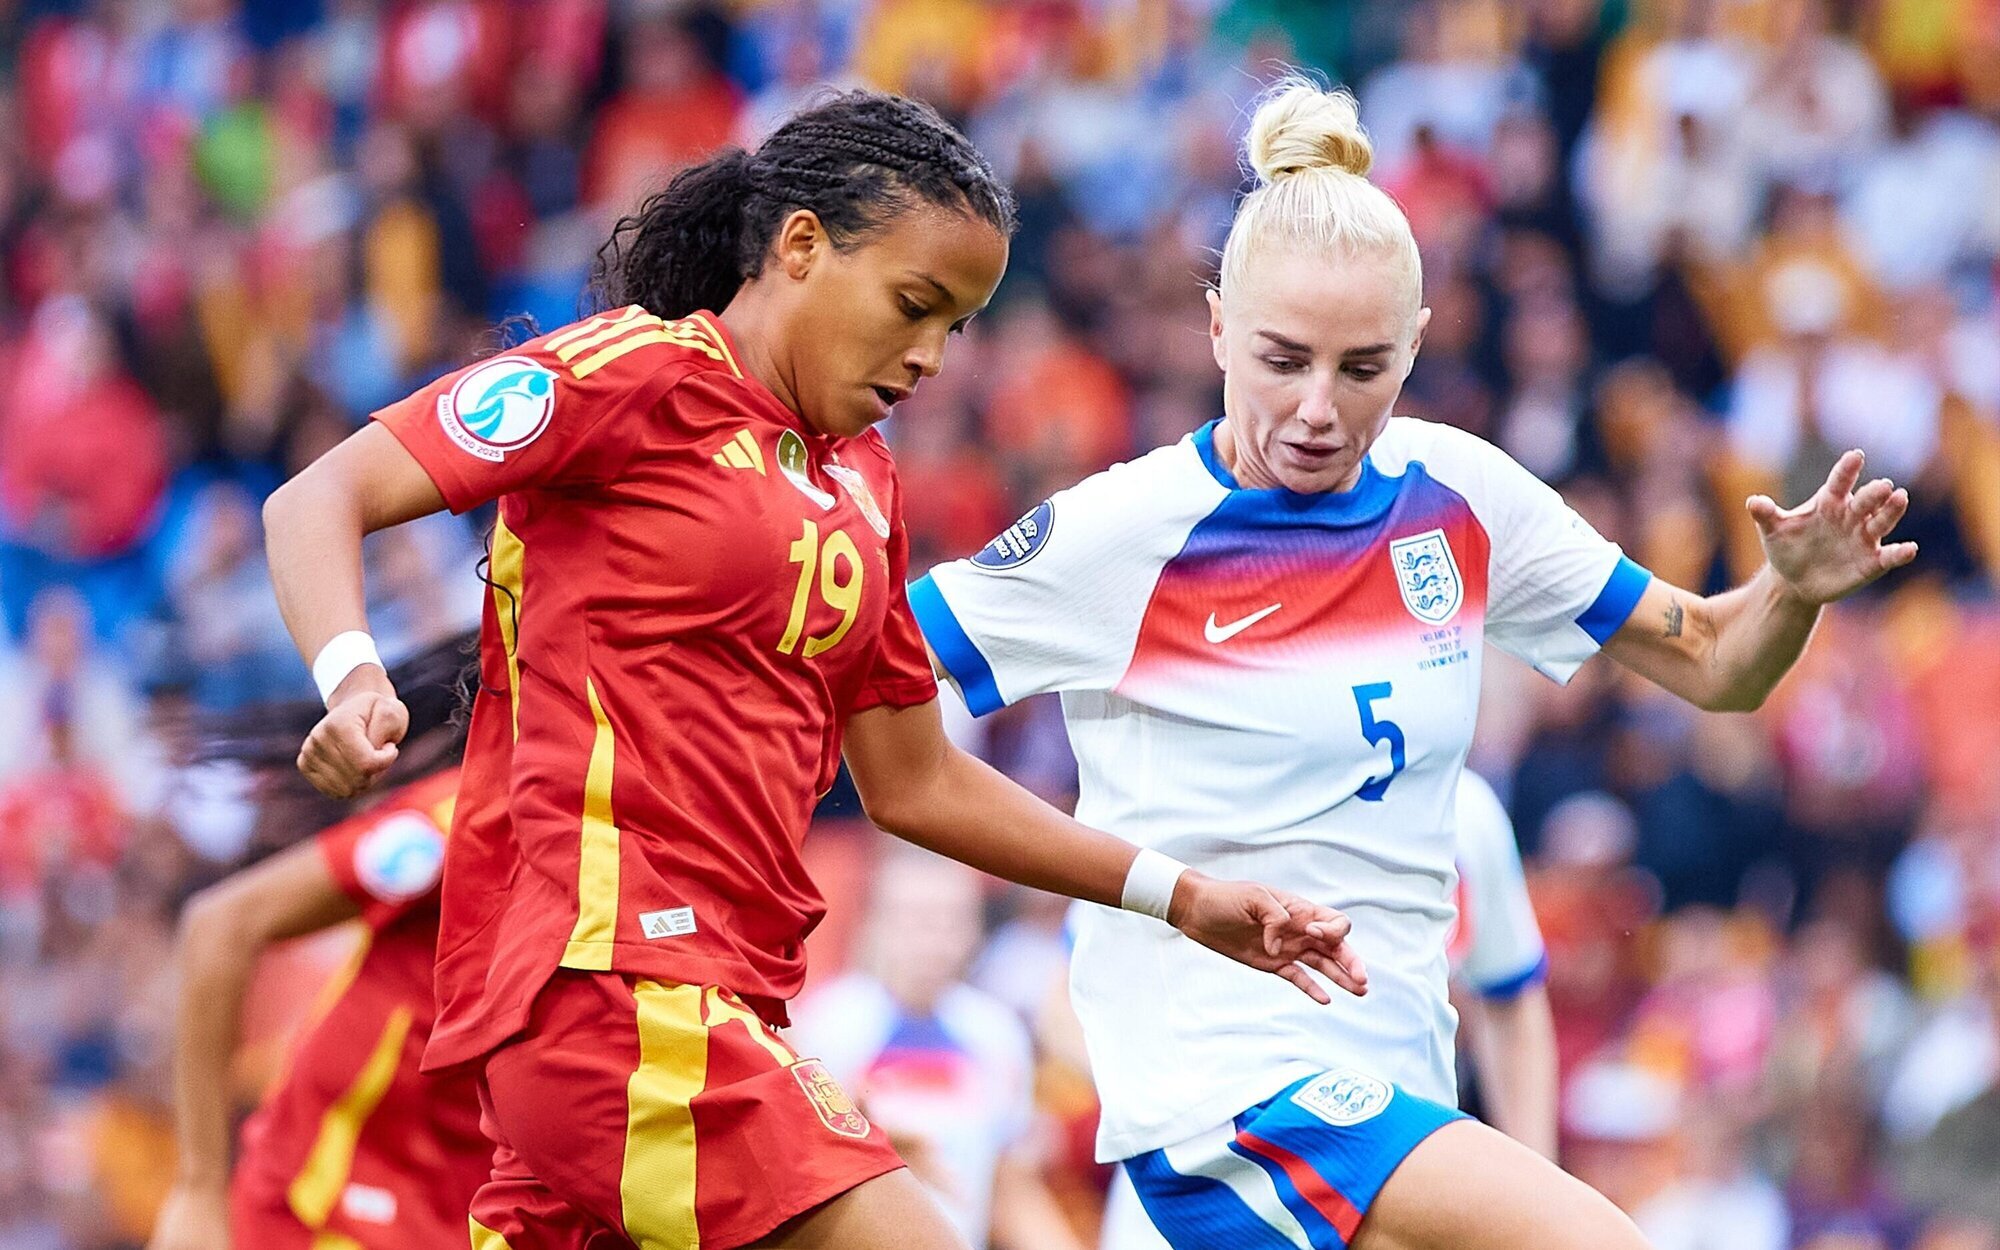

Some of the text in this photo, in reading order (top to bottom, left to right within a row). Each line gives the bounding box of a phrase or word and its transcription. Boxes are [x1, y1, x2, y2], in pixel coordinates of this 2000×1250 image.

[442, 398, 501, 458] SWITZERLAND 2025
[776, 518, 864, 658] 19
[1352, 681, 1405, 802] 5
